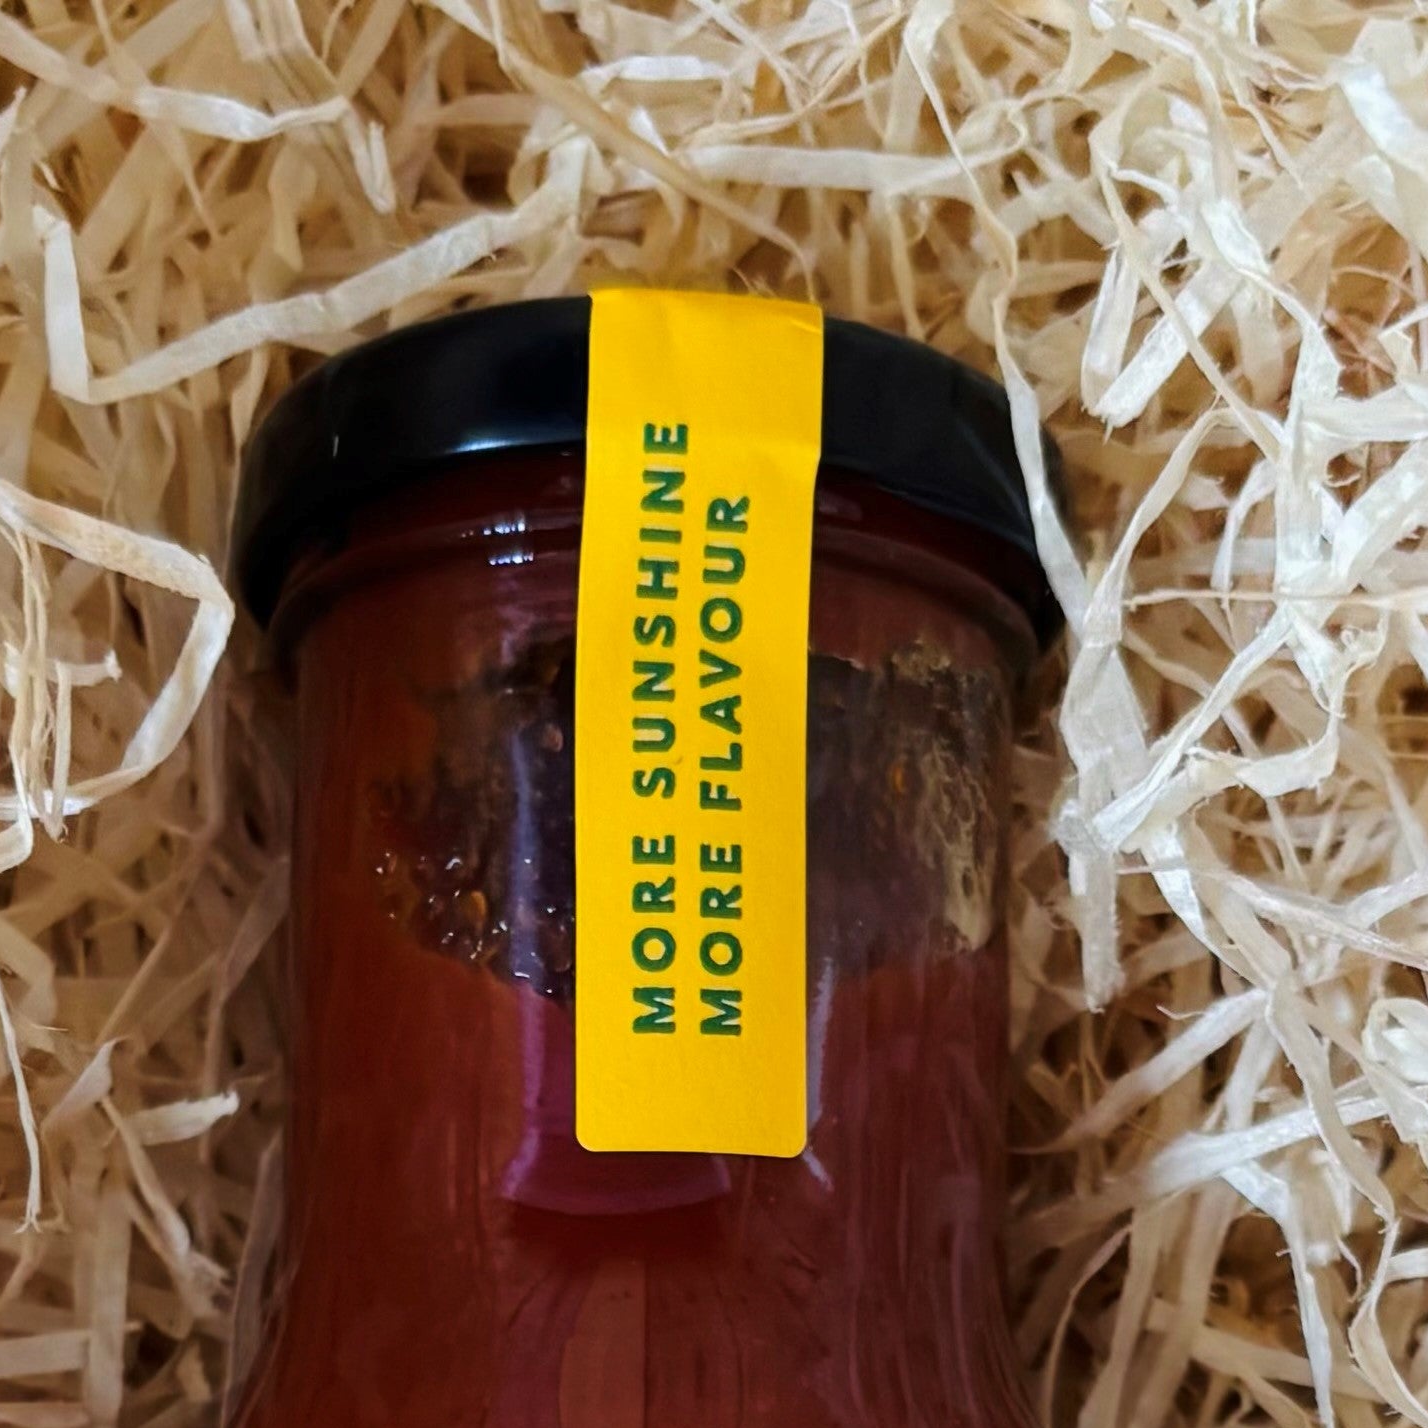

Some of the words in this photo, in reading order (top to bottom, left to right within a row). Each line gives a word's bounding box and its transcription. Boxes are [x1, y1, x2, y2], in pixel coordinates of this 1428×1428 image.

[632, 423, 689, 799] SUNSHINE
[699, 496, 750, 812] FLAVOUR
[632, 835, 676, 1034] MORE
[699, 844, 743, 1037] MORE
